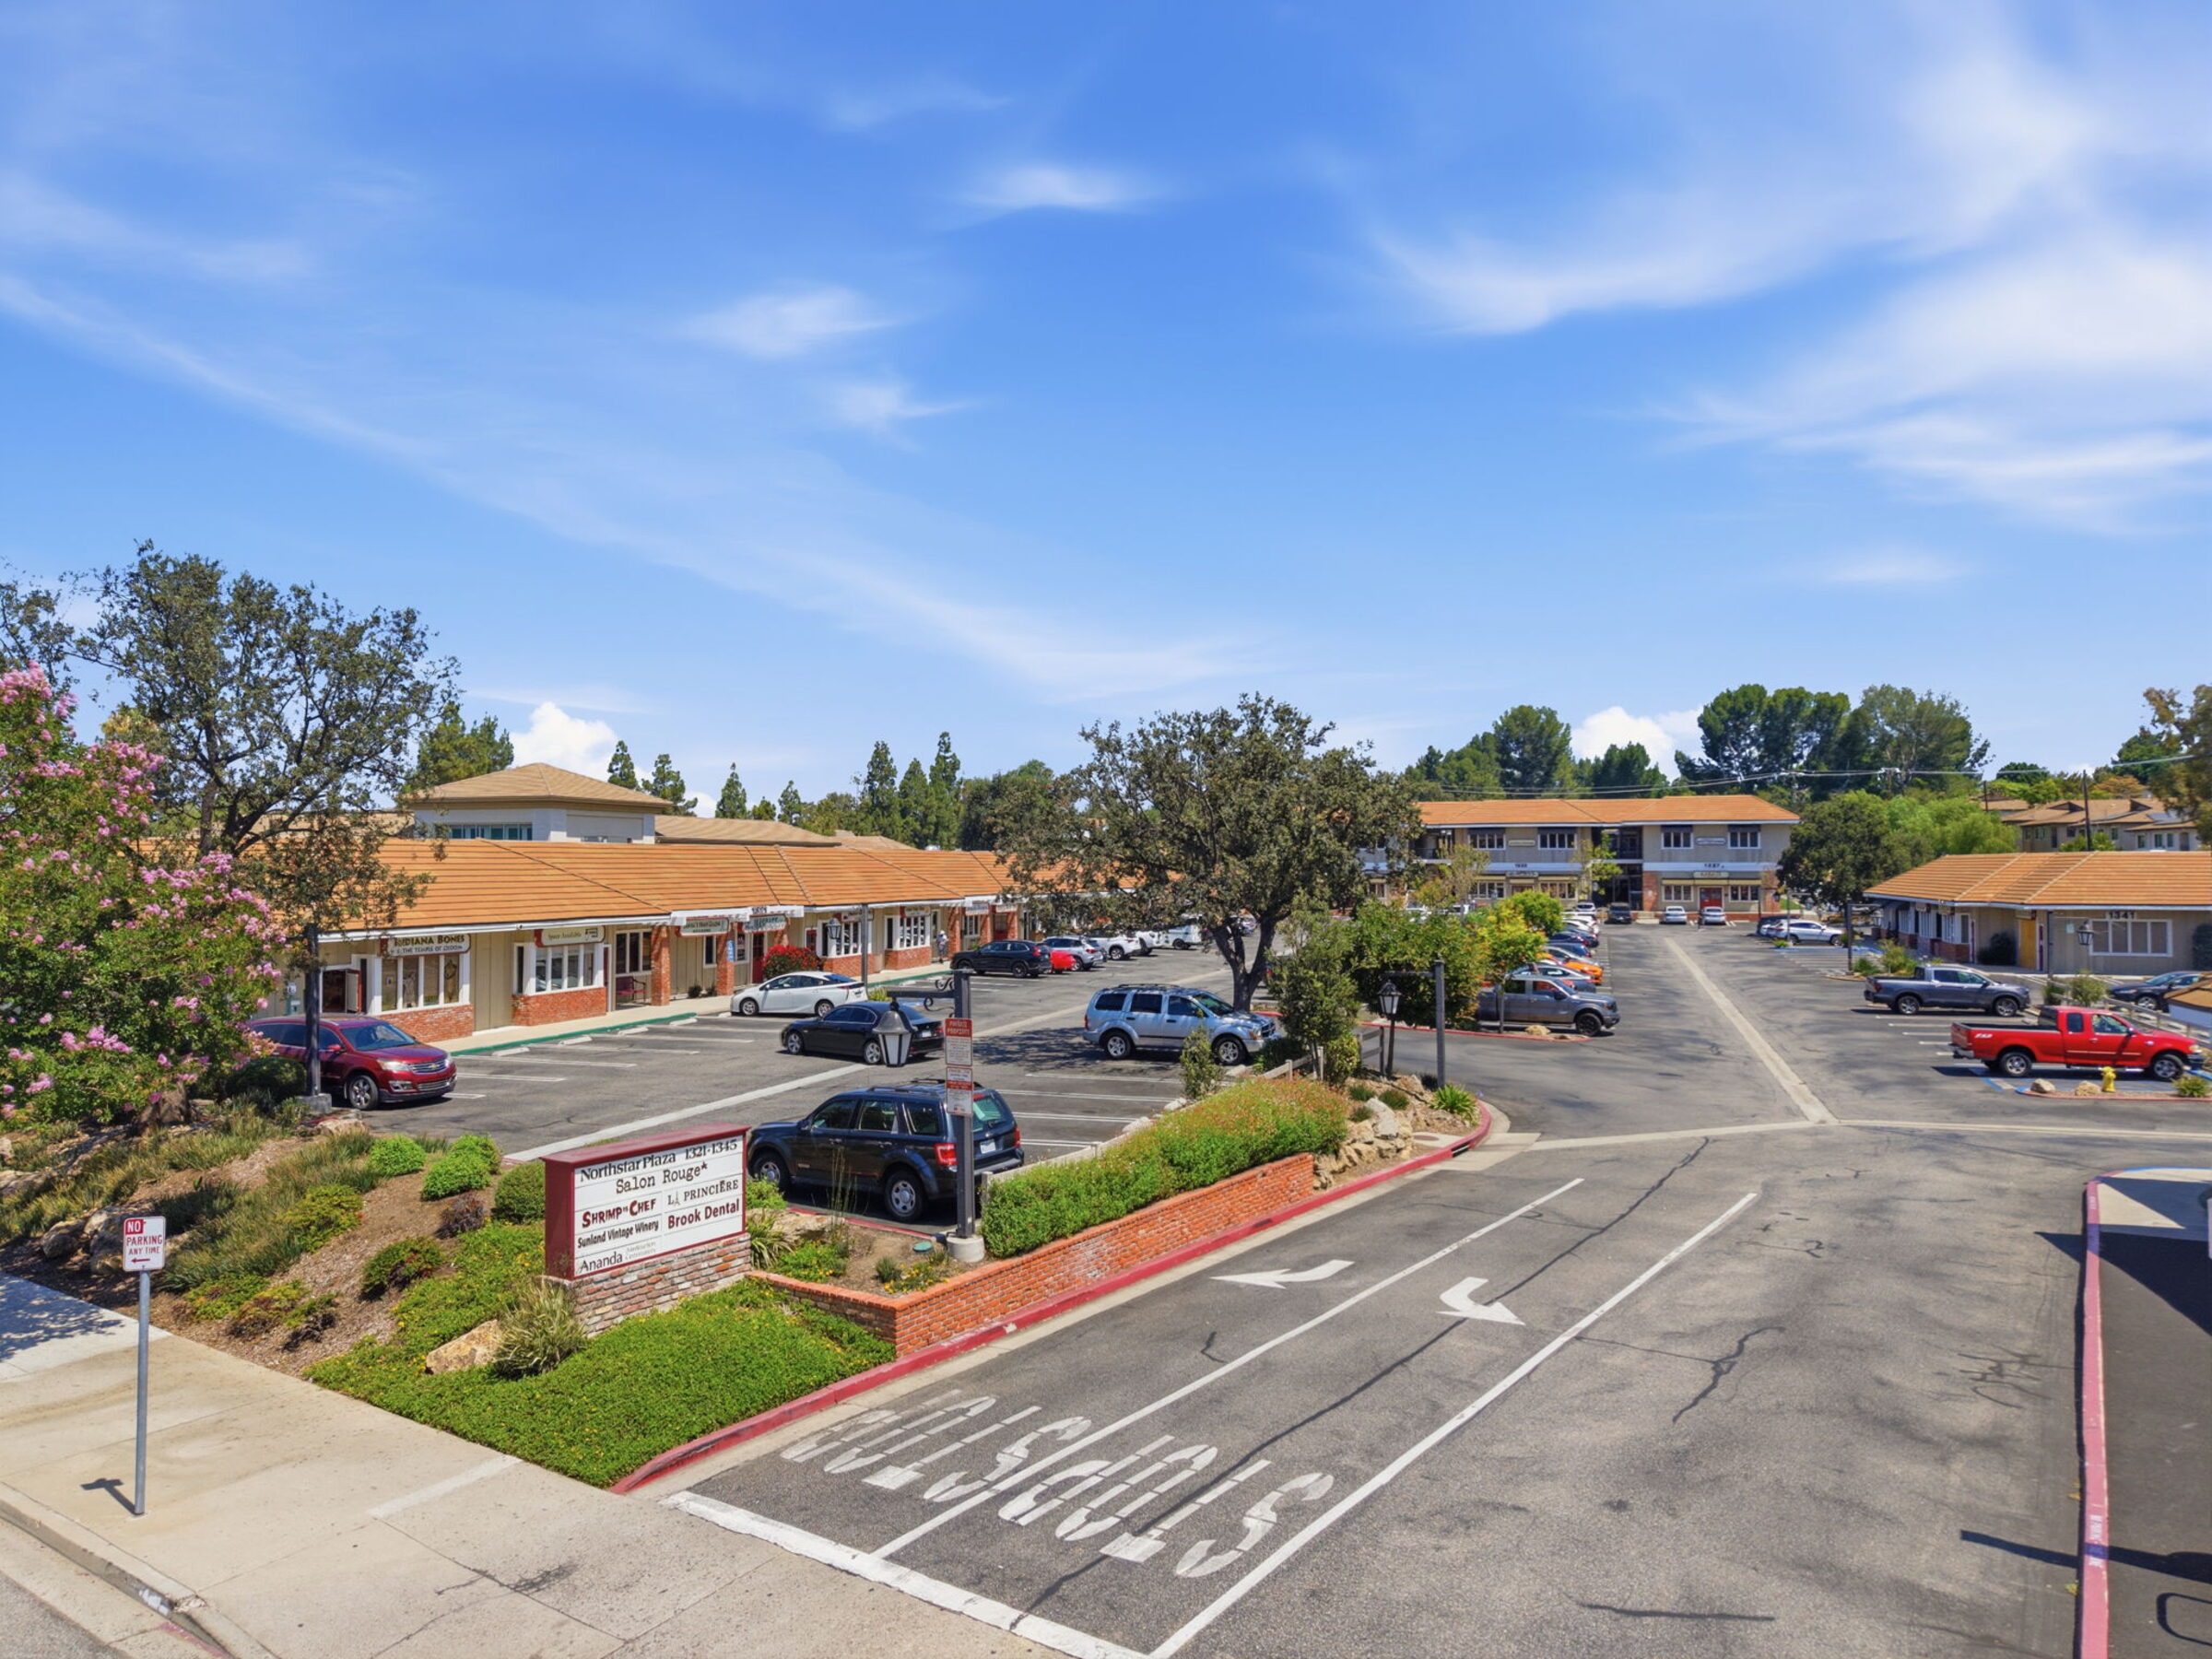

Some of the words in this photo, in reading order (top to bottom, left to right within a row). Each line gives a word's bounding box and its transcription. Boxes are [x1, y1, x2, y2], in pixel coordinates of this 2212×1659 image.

[438, 935, 465, 944] BONES
[580, 1159, 642, 1182] Northstar
[642, 1152, 677, 1170] Plaza
[616, 1175, 655, 1194] Salon
[582, 1206, 622, 1229] SHRIMP
[629, 1198, 656, 1217] CHEF
[667, 1208, 701, 1230] Brook
[704, 1198, 740, 1219] Dental
[127, 1220, 141, 1233] NO
[577, 1232, 606, 1249] Sunland
[607, 1227, 634, 1239] Vintage
[634, 1220, 659, 1234] Winery
[126, 1235, 162, 1245] PARKING
[129, 1247, 143, 1255] ANY
[146, 1246, 160, 1254] TIME
[578, 1251, 623, 1273] Ananda
[780, 1389, 1092, 1504] STOP
[998, 1434, 1335, 1578] STOP
